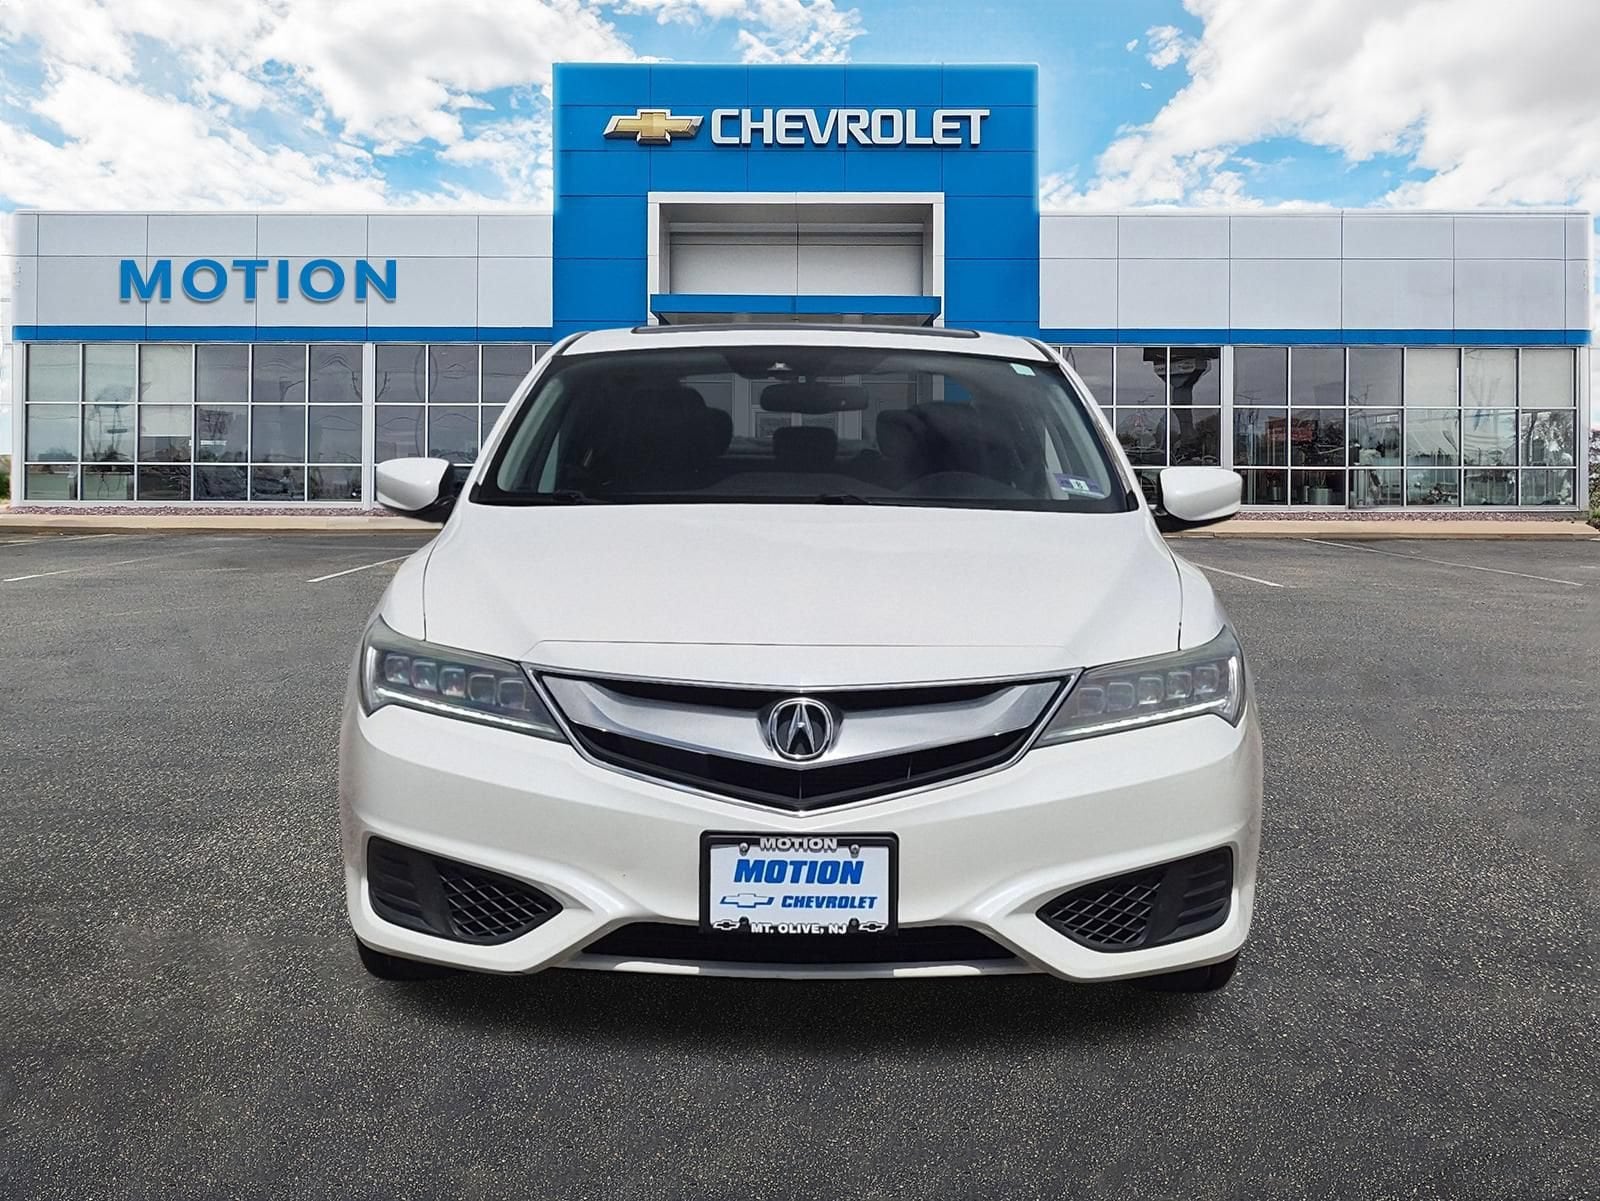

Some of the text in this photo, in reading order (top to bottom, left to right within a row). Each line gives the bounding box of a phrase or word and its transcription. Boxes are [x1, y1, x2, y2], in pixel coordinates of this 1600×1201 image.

[711, 108, 990, 145] CHEVROLET
[120, 259, 397, 302] MOTION
[760, 838, 838, 852] MOTION
[734, 859, 864, 885] MOTION
[781, 895, 877, 909] CHEVROLET
[751, 922, 847, 935] MT. OLIVE, NJ
